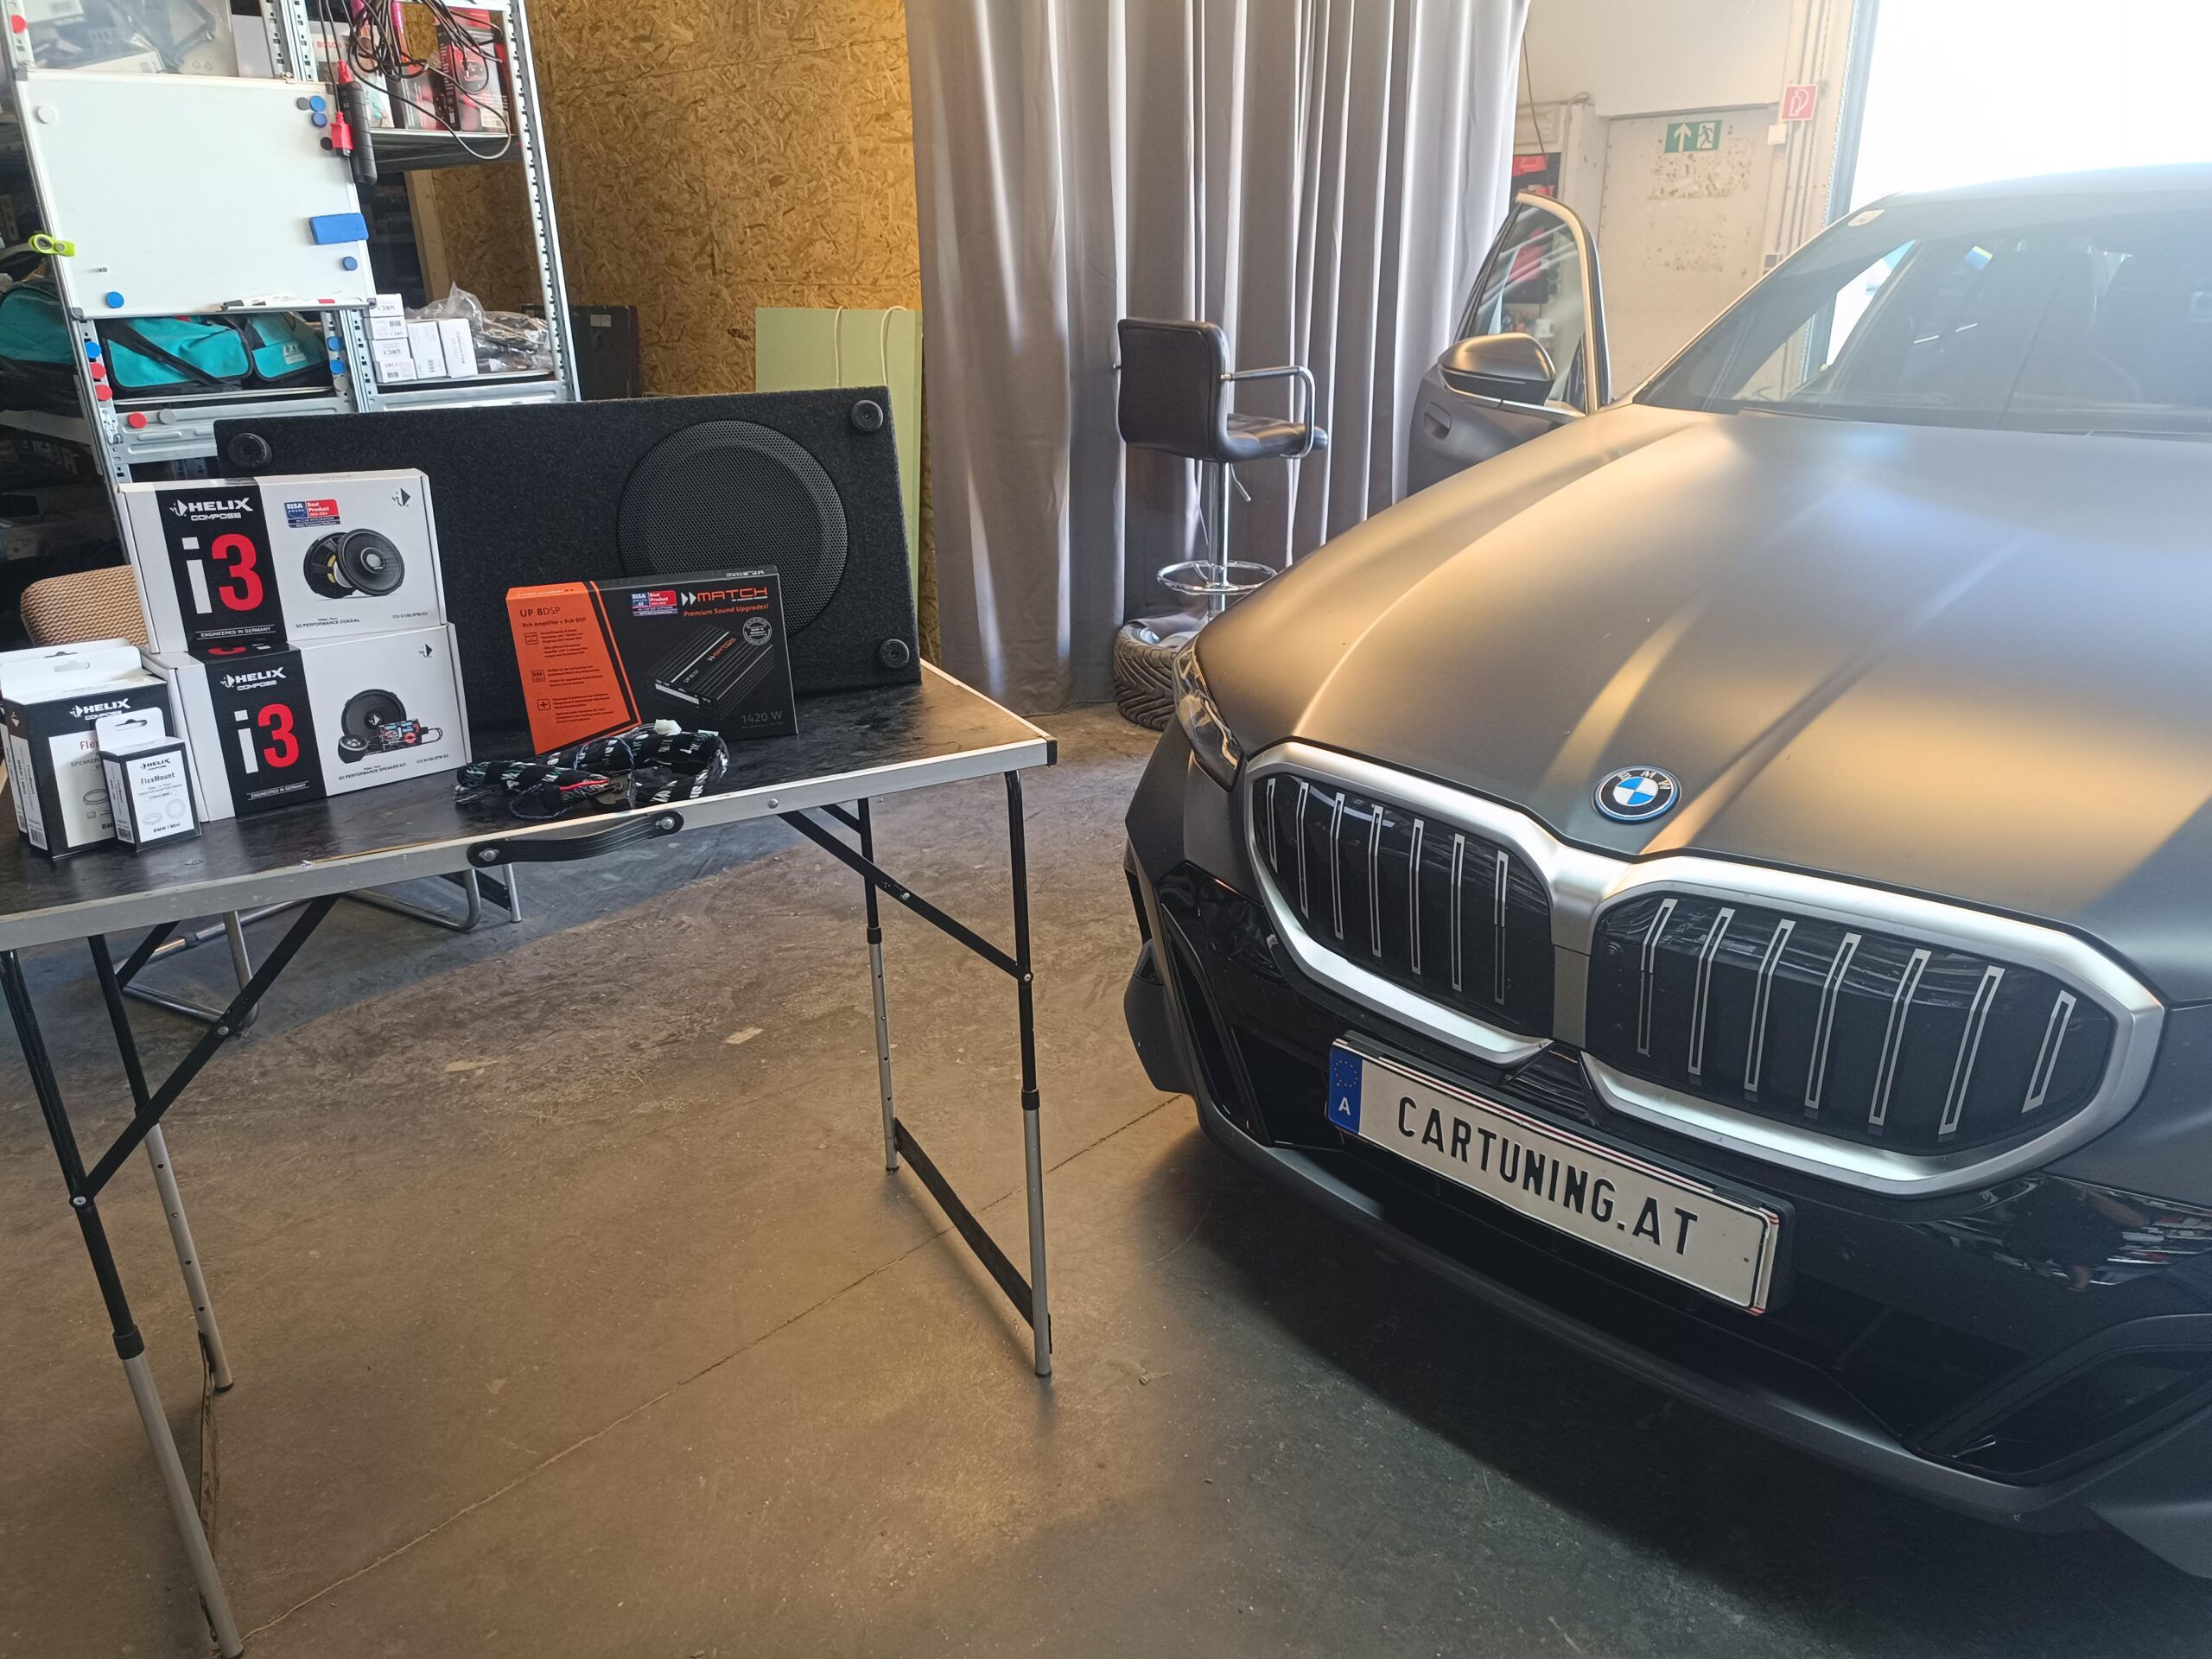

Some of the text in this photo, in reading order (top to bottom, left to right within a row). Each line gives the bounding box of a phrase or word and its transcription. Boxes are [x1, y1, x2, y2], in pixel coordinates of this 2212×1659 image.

[188, 497, 254, 512] HELIX
[190, 512, 242, 521] COMPOSE
[181, 533, 264, 614] i3
[697, 586, 768, 602] MATCH
[519, 606, 561, 617] UP 8DSP
[683, 603, 769, 617] Premium Sound Upgrades!
[200, 629, 237, 638] ENGINEERED
[234, 666, 287, 683] HELIX
[237, 679, 277, 690] COMPOSE
[82, 697, 131, 714] HELIX
[85, 709, 123, 721] COMPO
[741, 710, 782, 723] 1420 W
[233, 703, 300, 774] i3
[140, 772, 175, 785] FlexMount
[345, 768, 378, 779] PERFORMANCE
[1617, 770, 1671, 790] BMW
[251, 787, 279, 798] ENGINEERED
[1338, 1096, 1352, 1117] A
[1398, 1095, 1699, 1256] CARTUNING.AT
